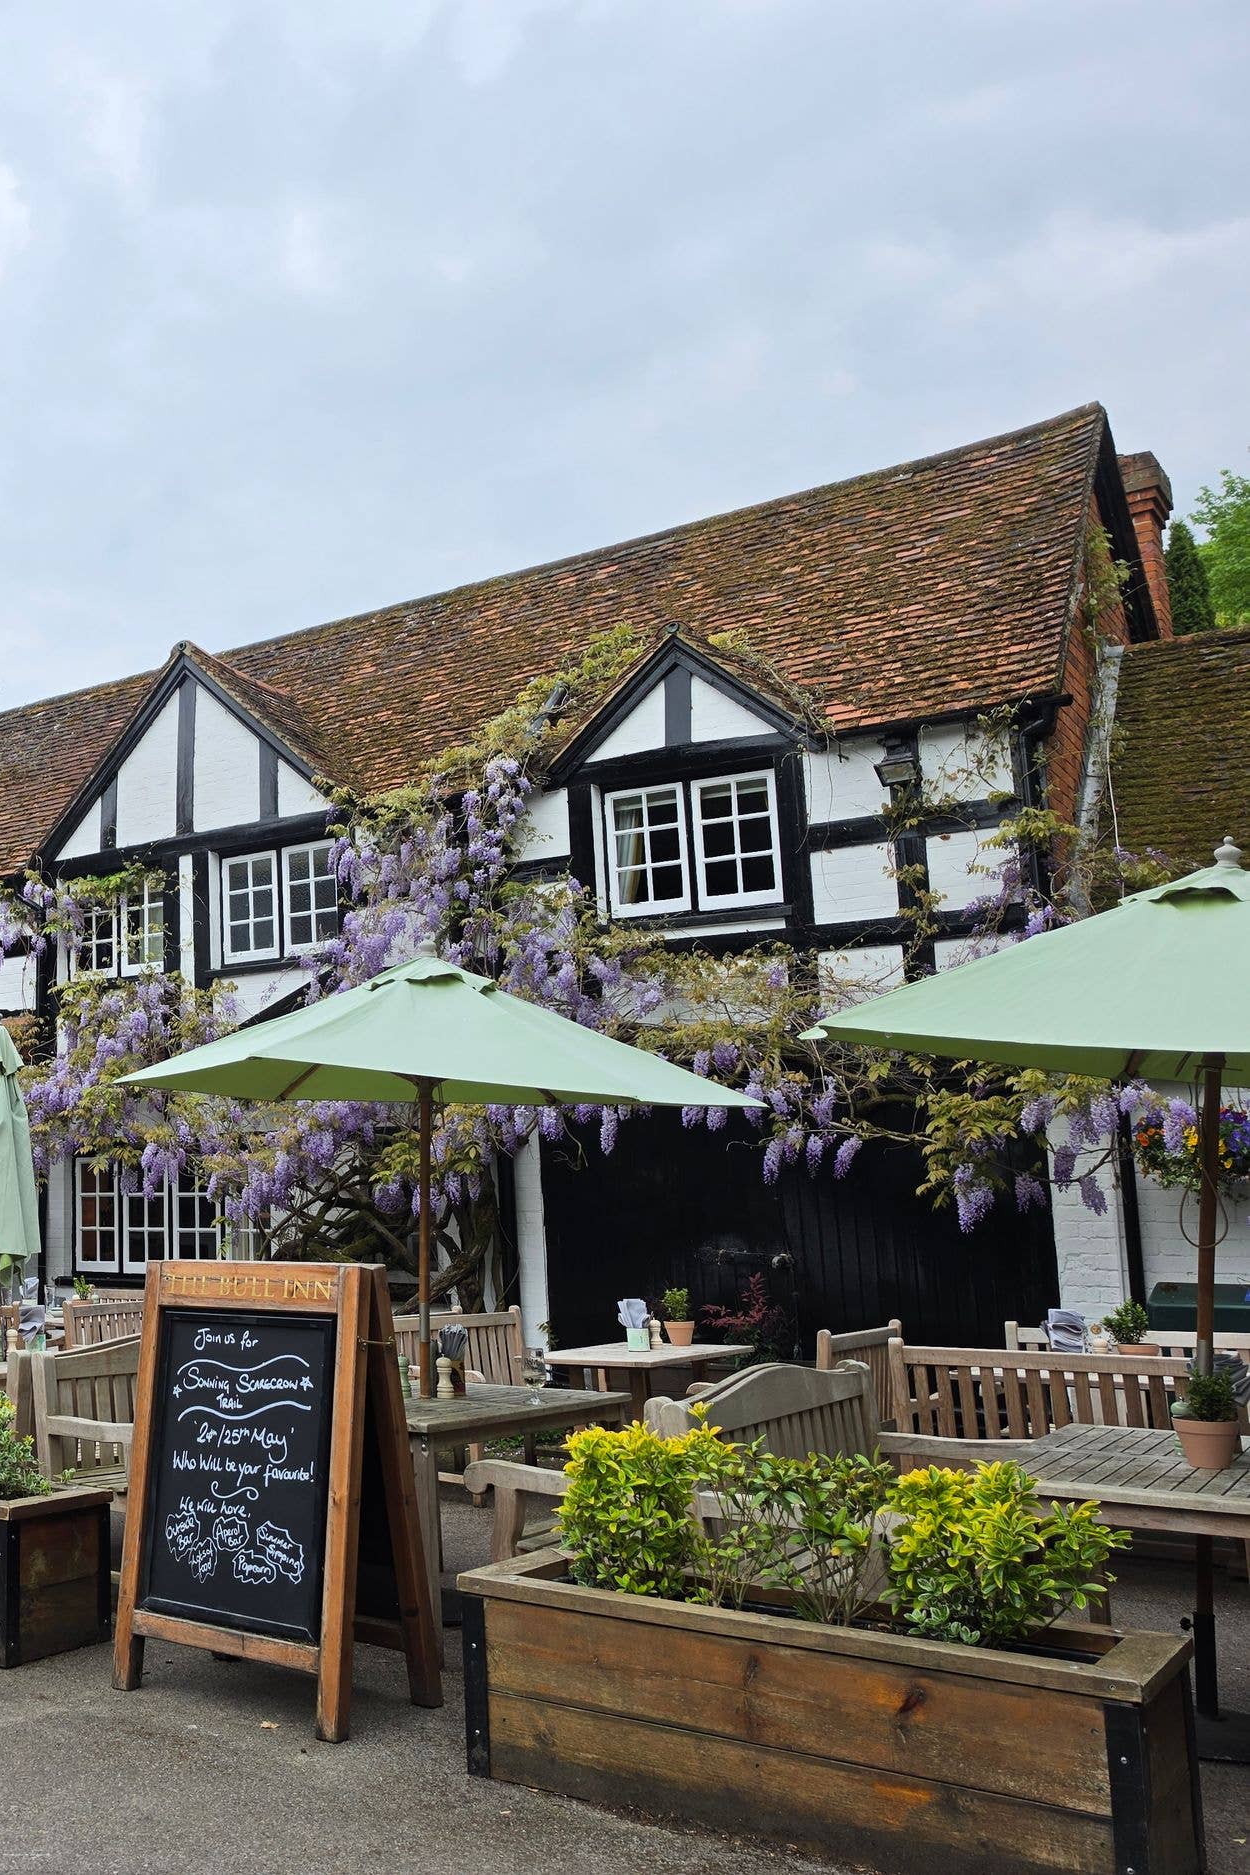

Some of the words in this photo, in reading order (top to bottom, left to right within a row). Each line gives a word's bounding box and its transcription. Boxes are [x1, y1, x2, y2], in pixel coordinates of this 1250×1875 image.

[167, 1274, 209, 1296] THE
[219, 1275, 276, 1298] BULL
[283, 1278, 333, 1301] INN
[193, 1327, 222, 1351] Join
[224, 1333, 236, 1345] us
[240, 1329, 259, 1351] for
[173, 1449, 197, 1471] Who
[225, 1456, 238, 1472] be
[236, 1461, 262, 1487] your
[263, 1461, 315, 1488] favourite!
[179, 1496, 195, 1512] We
[176, 1532, 194, 1551] Bar
[215, 1523, 241, 1543] Aperol
[227, 1535, 245, 1547] Bar
[237, 1554, 271, 1576] Popcorn
